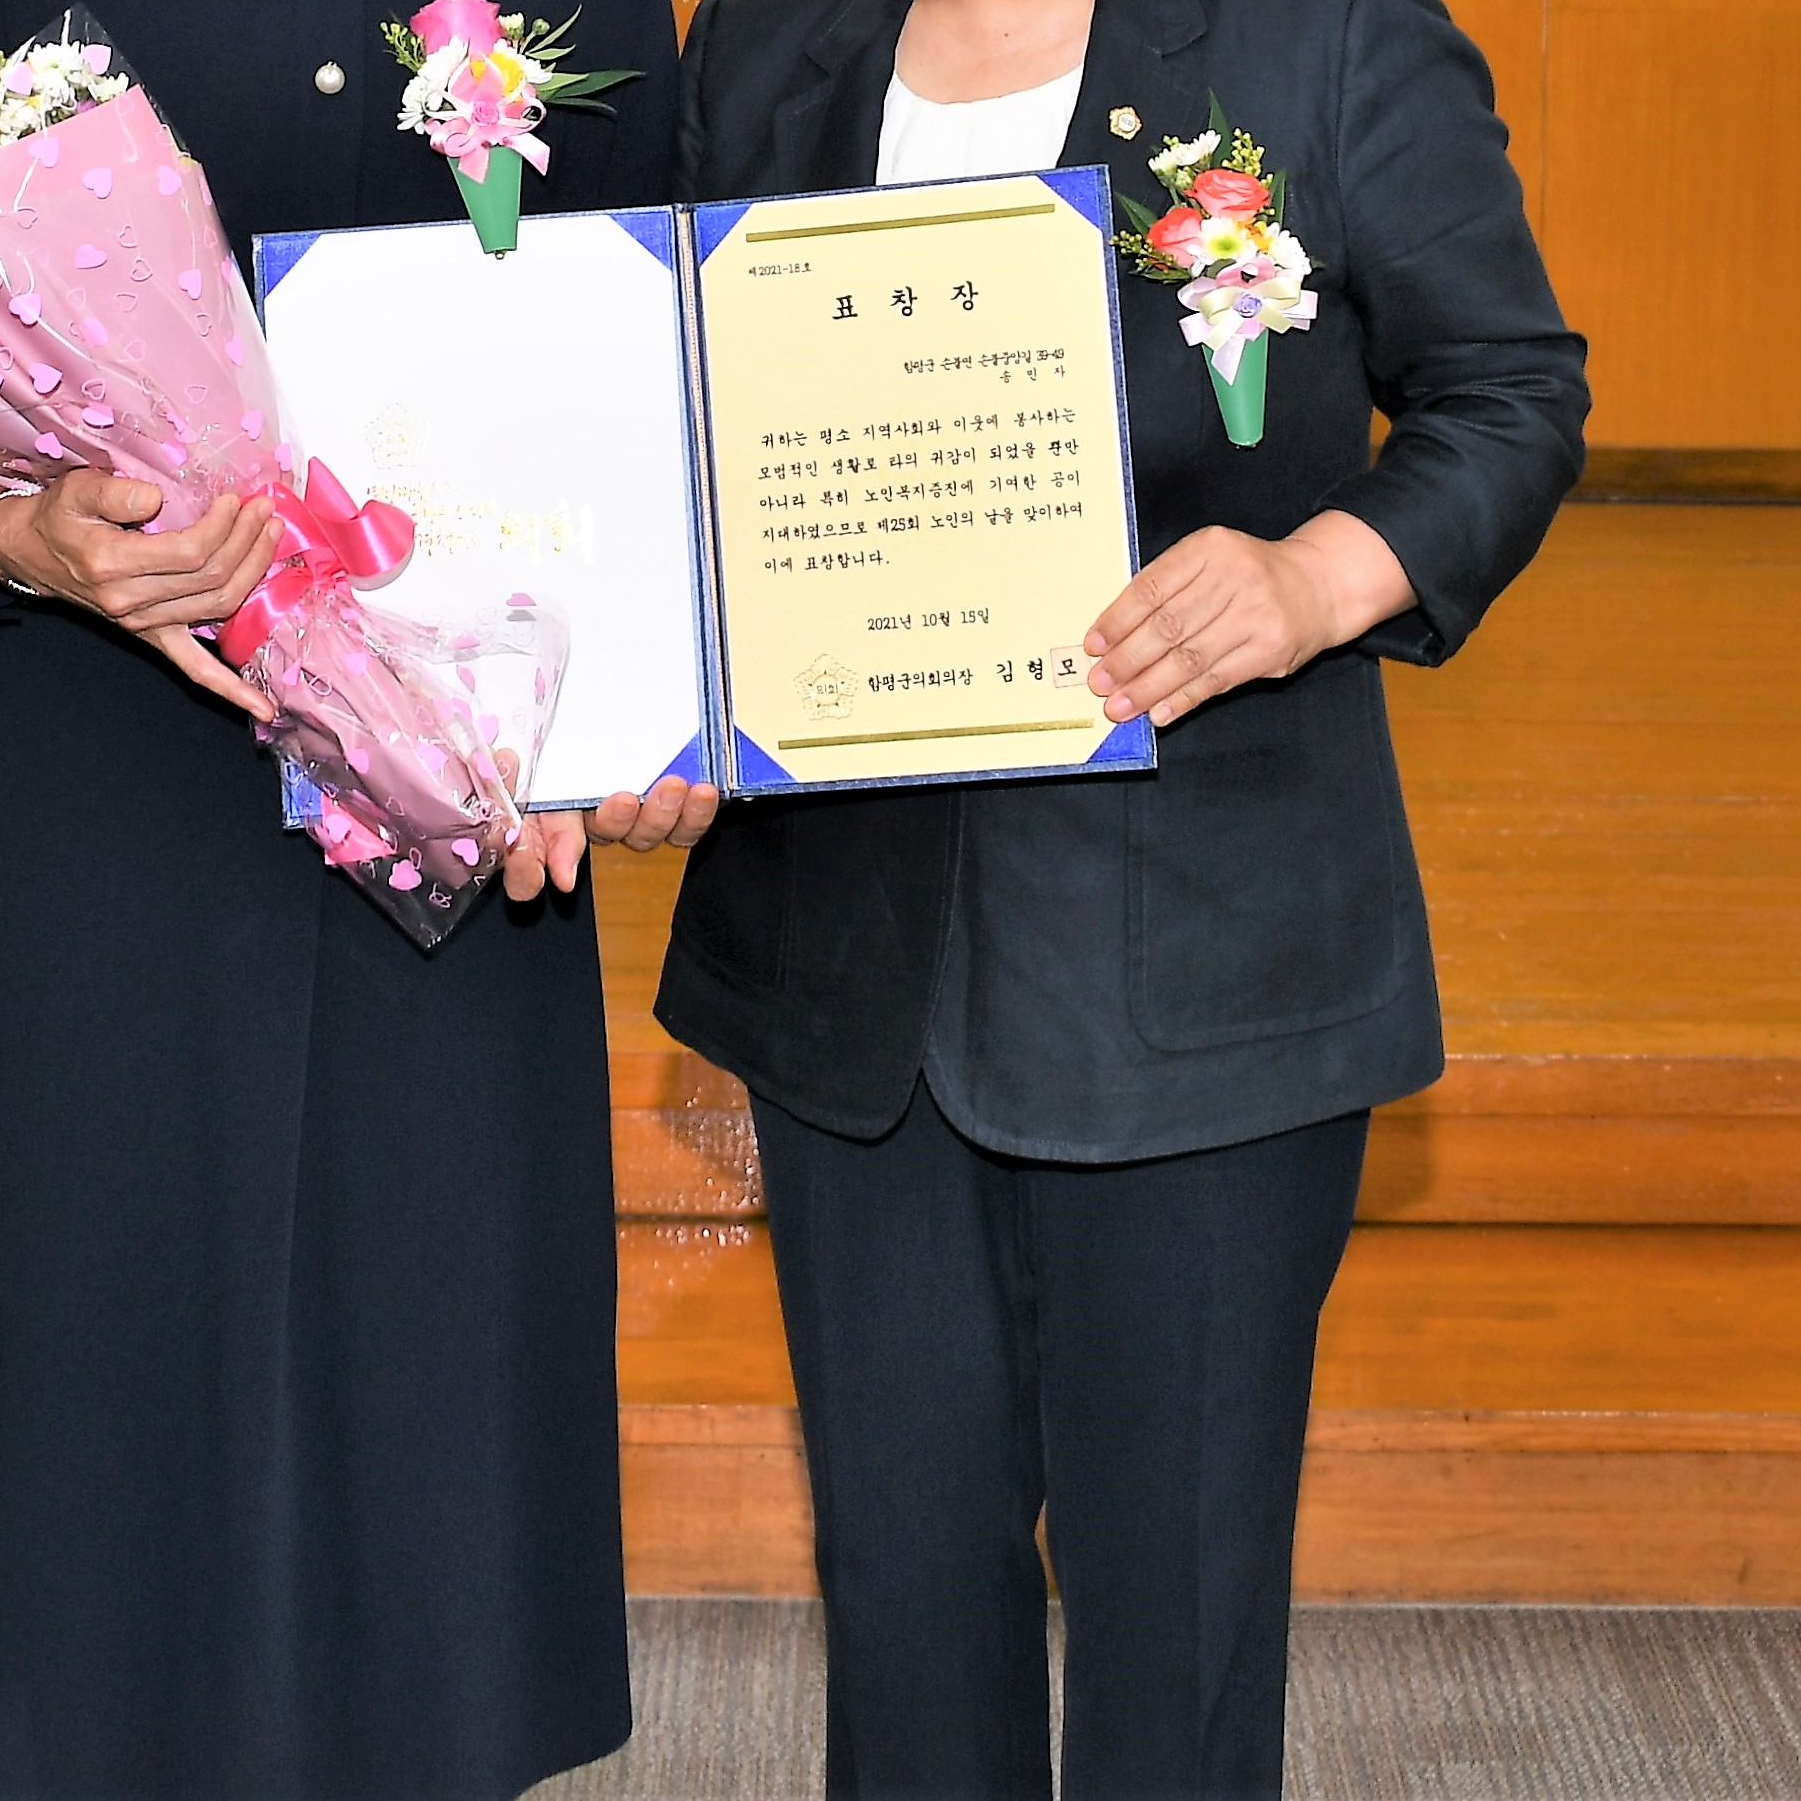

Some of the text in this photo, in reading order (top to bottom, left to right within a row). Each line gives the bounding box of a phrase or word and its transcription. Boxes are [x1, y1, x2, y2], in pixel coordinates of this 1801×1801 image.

[760, 409, 1076, 449] 귀하는 평소 지역사회와 이웃에 봉사하는
[757, 461, 818, 480] 모범적인
[832, 457, 878, 475] 생활로
[930, 447, 976, 466] 귀감이
[989, 443, 1036, 461] 되었을
[759, 470, 1080, 512] 아니라 특히 노인복지증진에 기여한 공이
[762, 502, 1082, 543] 지대하였으므로 제25회 노인의 날을 맞이하여
[764, 550, 890, 574] 이에 표창합니다.
[867, 608, 989, 631] 2021년 10월 15일
[867, 669, 974, 693] 함평군의회의장
